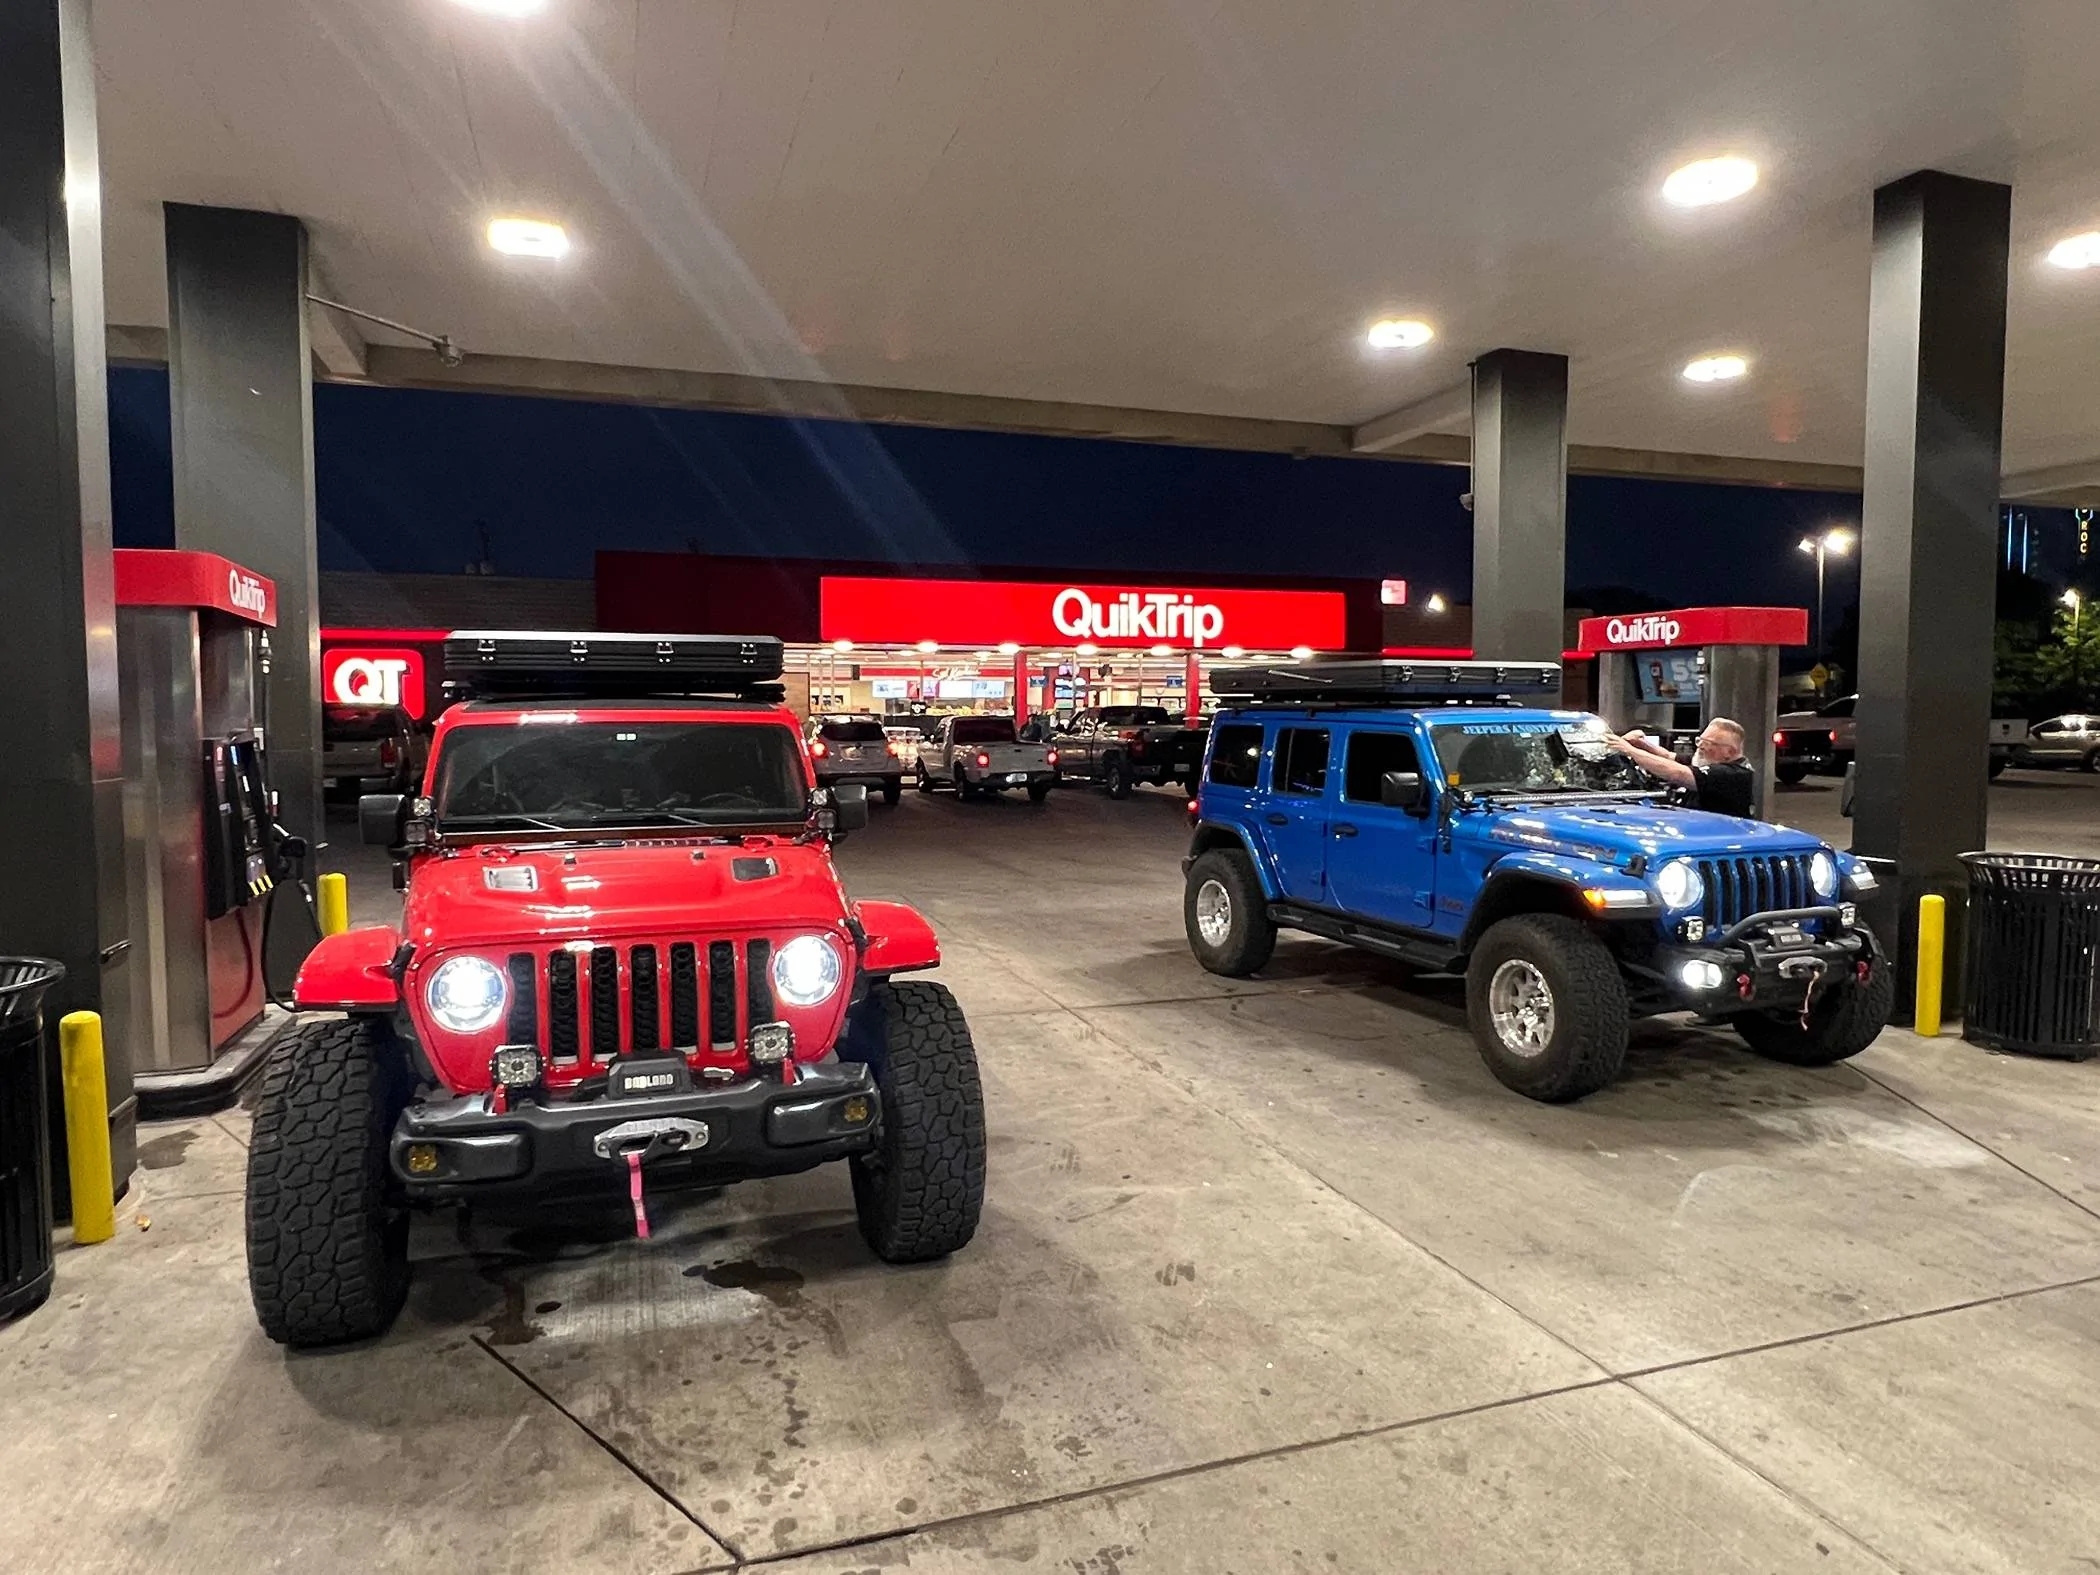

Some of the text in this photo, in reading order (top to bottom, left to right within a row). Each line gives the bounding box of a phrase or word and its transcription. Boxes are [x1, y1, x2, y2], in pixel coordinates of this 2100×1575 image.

[229, 569, 265, 619] QuikTrip
[1052, 588, 1223, 647] QuikTrip
[1606, 616, 1680, 645] QuikTrip
[333, 657, 407, 705] QT
[1462, 724, 1511, 735] JEEPERS
